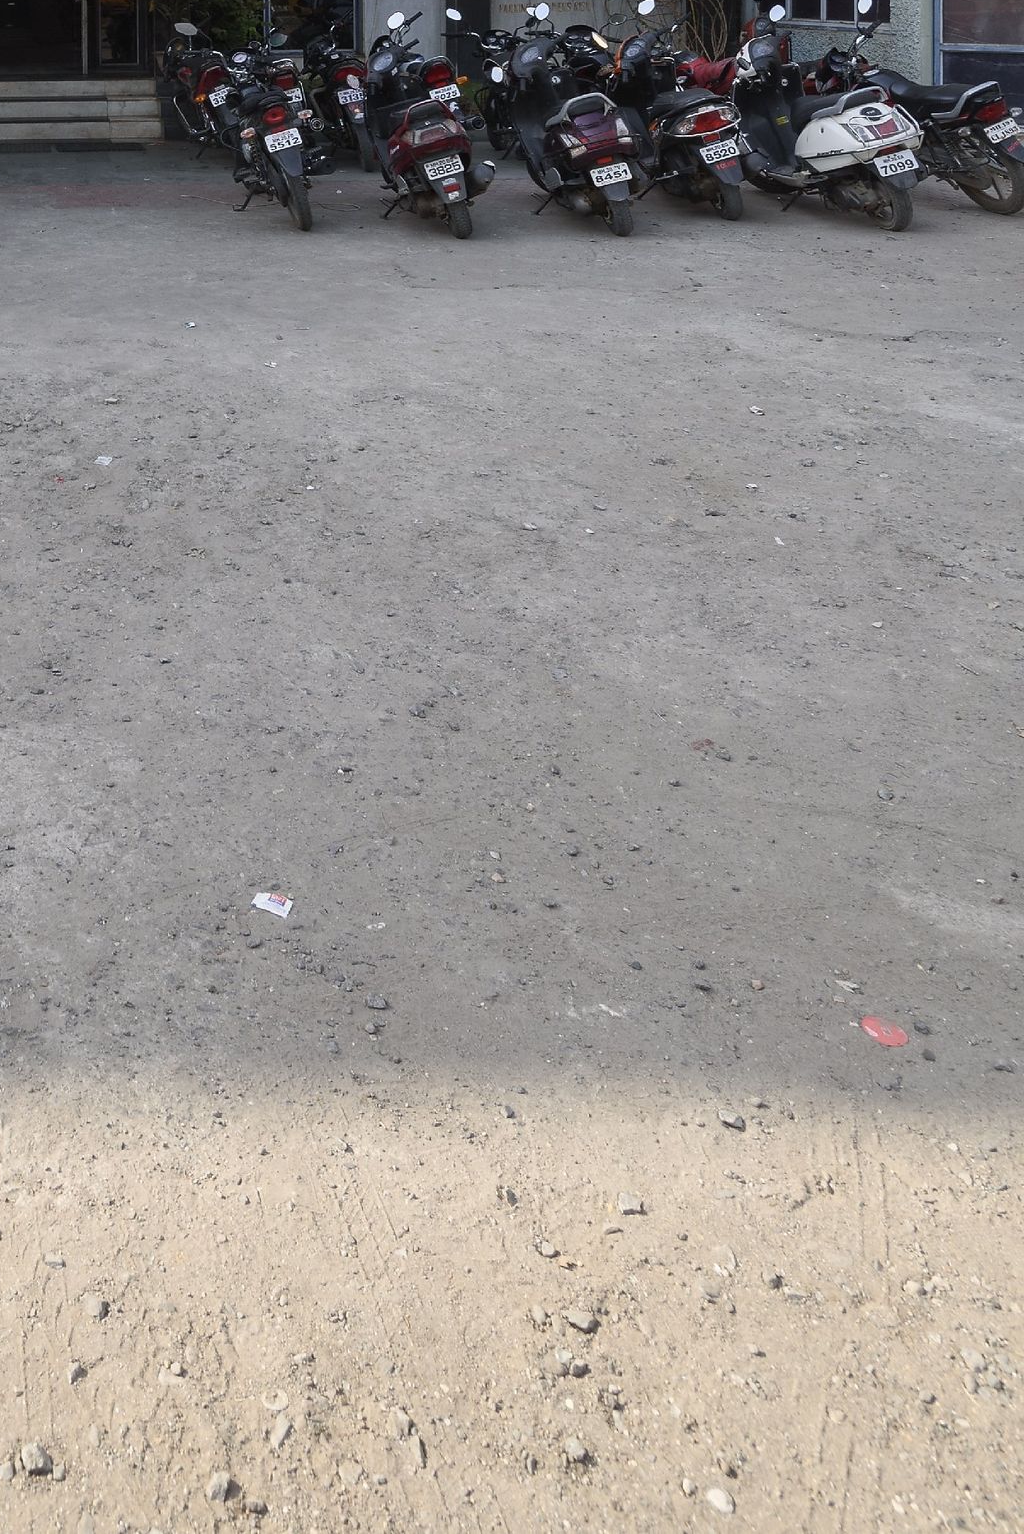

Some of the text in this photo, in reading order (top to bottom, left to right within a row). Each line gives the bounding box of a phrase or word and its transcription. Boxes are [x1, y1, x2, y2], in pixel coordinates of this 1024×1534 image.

[705, 146, 736, 161] 8520
[880, 159, 914, 175] 7099
[595, 169, 628, 183] 8451
